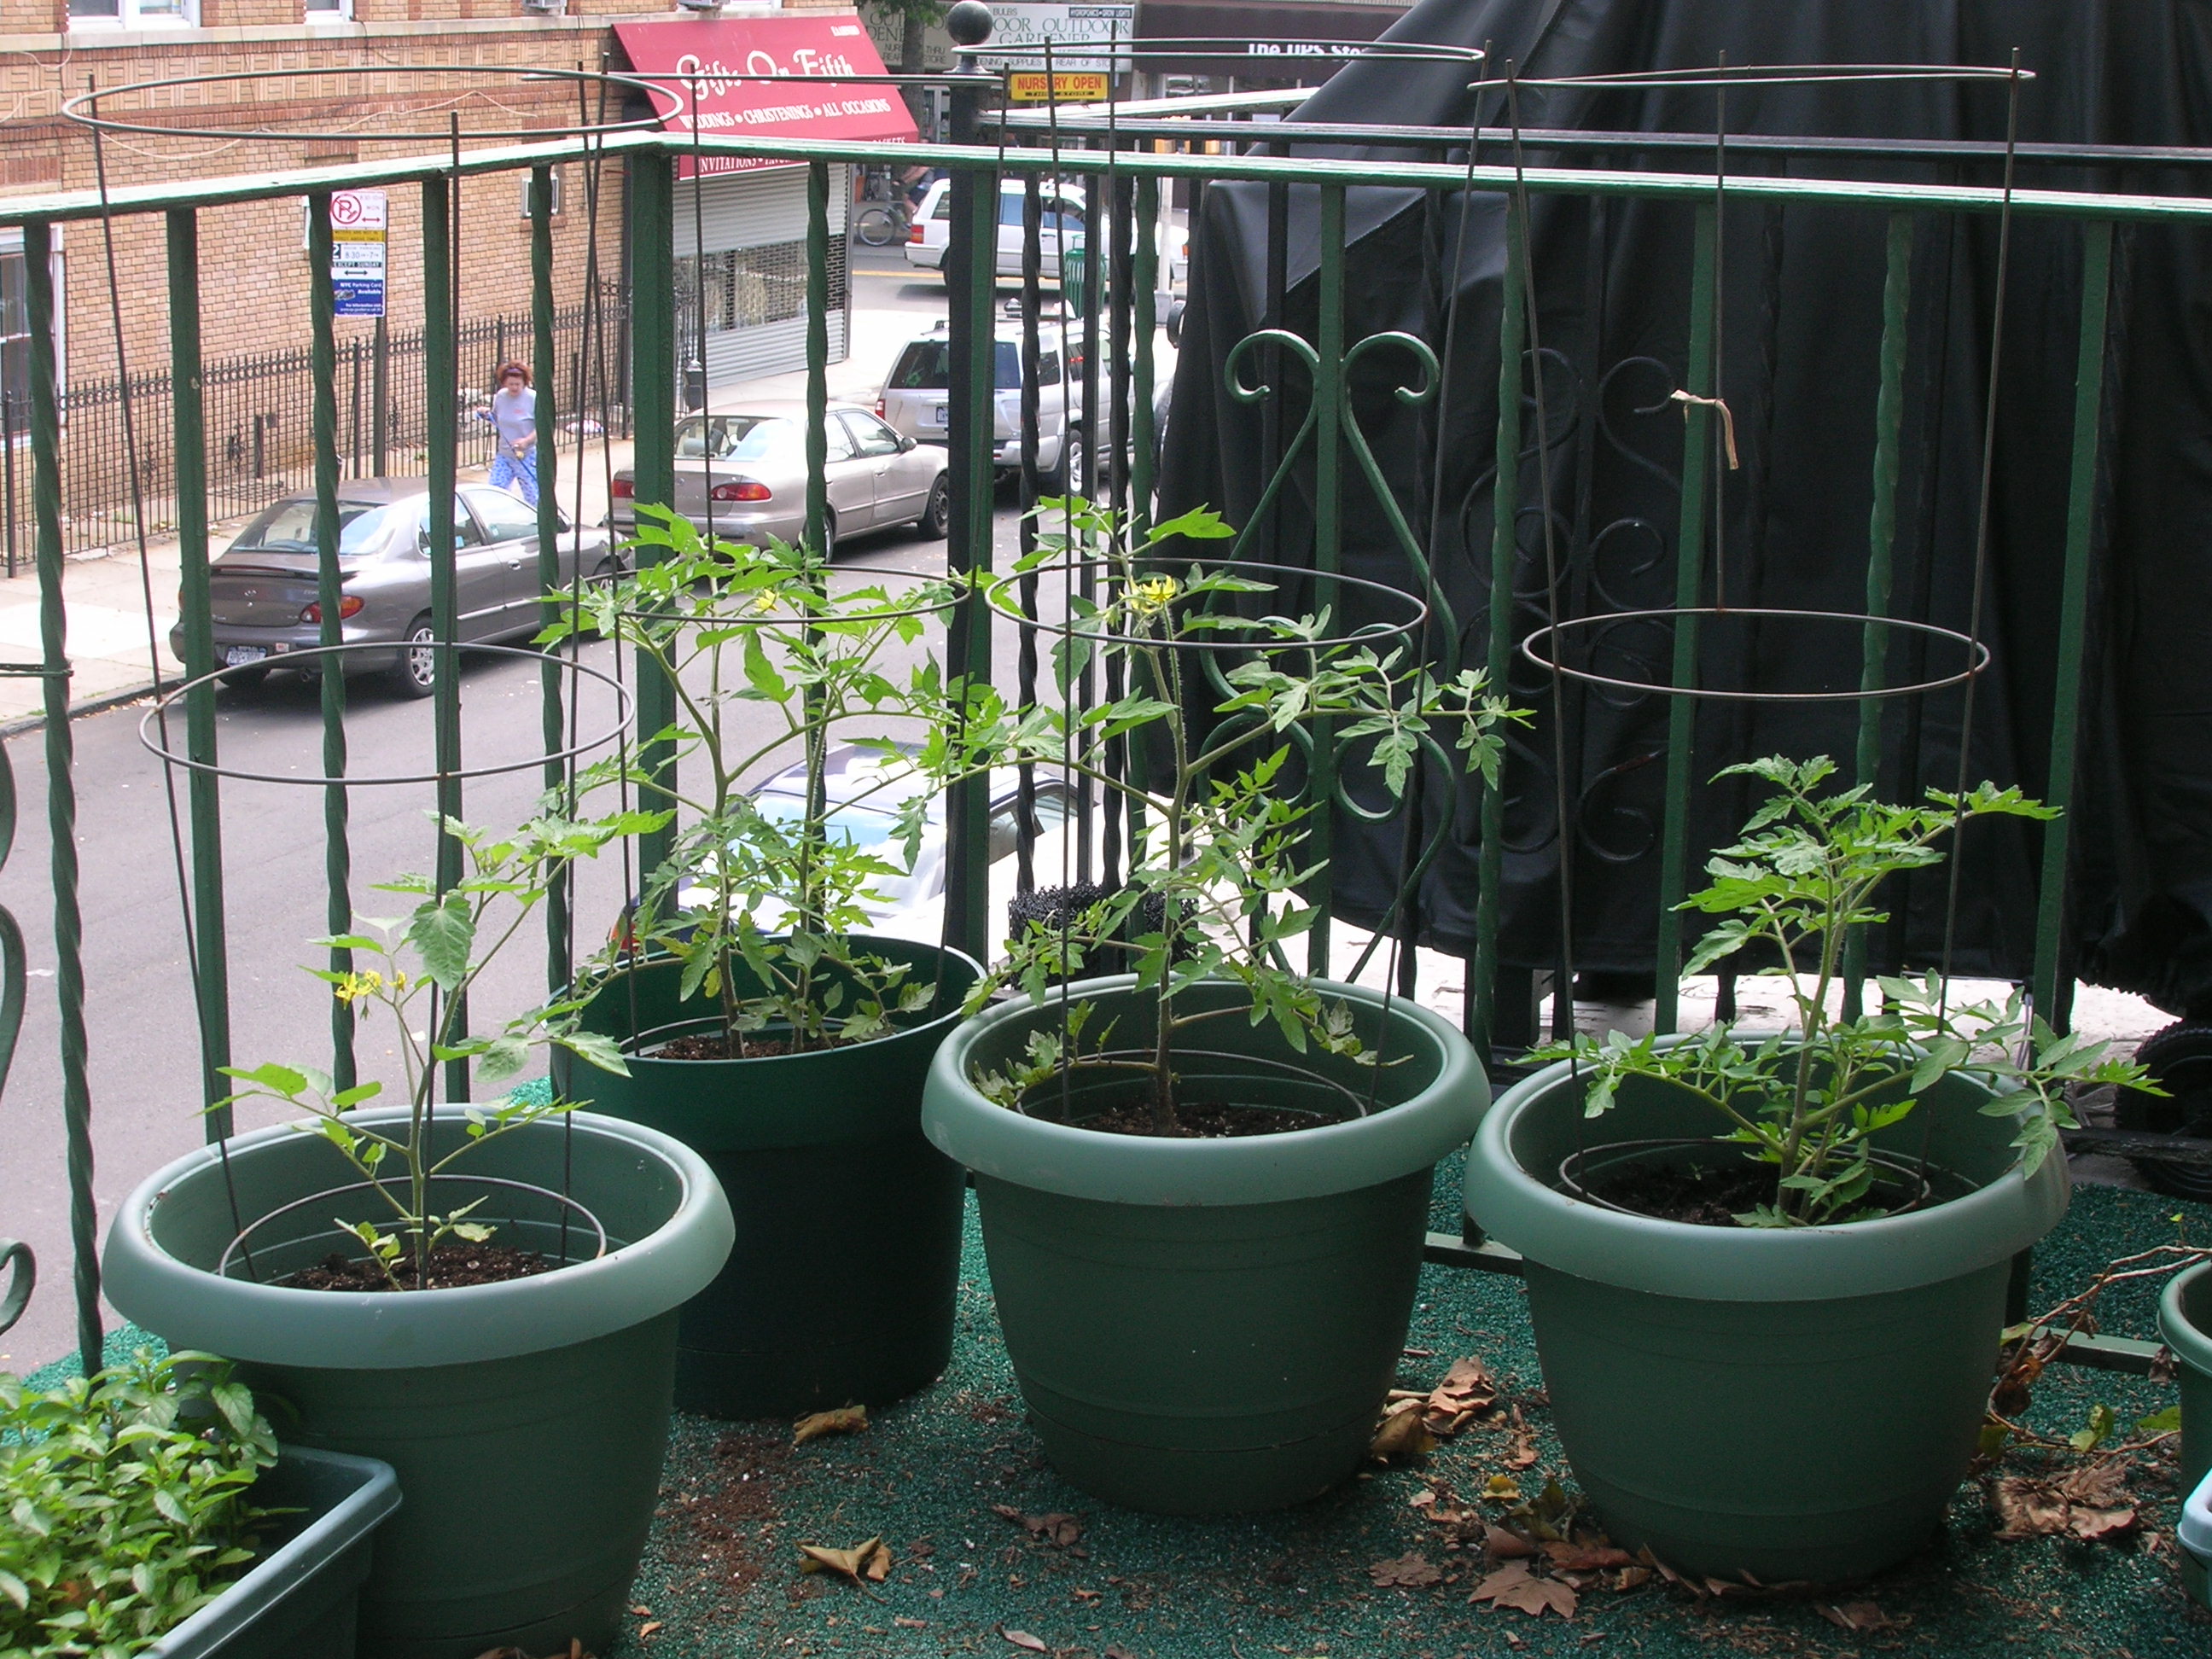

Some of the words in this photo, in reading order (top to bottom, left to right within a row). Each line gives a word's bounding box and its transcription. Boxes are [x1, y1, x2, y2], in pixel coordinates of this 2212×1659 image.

[992, 8, 1017, 16] BULBS
[992, 18, 1031, 32] OOR
[1042, 18, 1130, 33] OUTDOOR
[1287, 44, 1324, 61] UPS
[1330, 44, 1365, 61] Sto
[1008, 57, 1042, 67] SUPPLIES
[1055, 57, 1077, 67] REAR
[1080, 58, 1091, 67] OF
[1096, 58, 1121, 68] STOE
[676, 54, 742, 100] Gifts
[747, 50, 790, 84] On
[793, 49, 856, 86] Fifth
[1017, 77, 1068, 90] NURSRY
[1073, 77, 1102, 90] OPEN
[678, 112, 735, 130] WDDINGS
[742, 104, 814, 125] CHRISTENINGS
[823, 102, 843, 118] ALL
[841, 98, 892, 115] OCCASIONS
[698, 156, 757, 172] NVITATIONS
